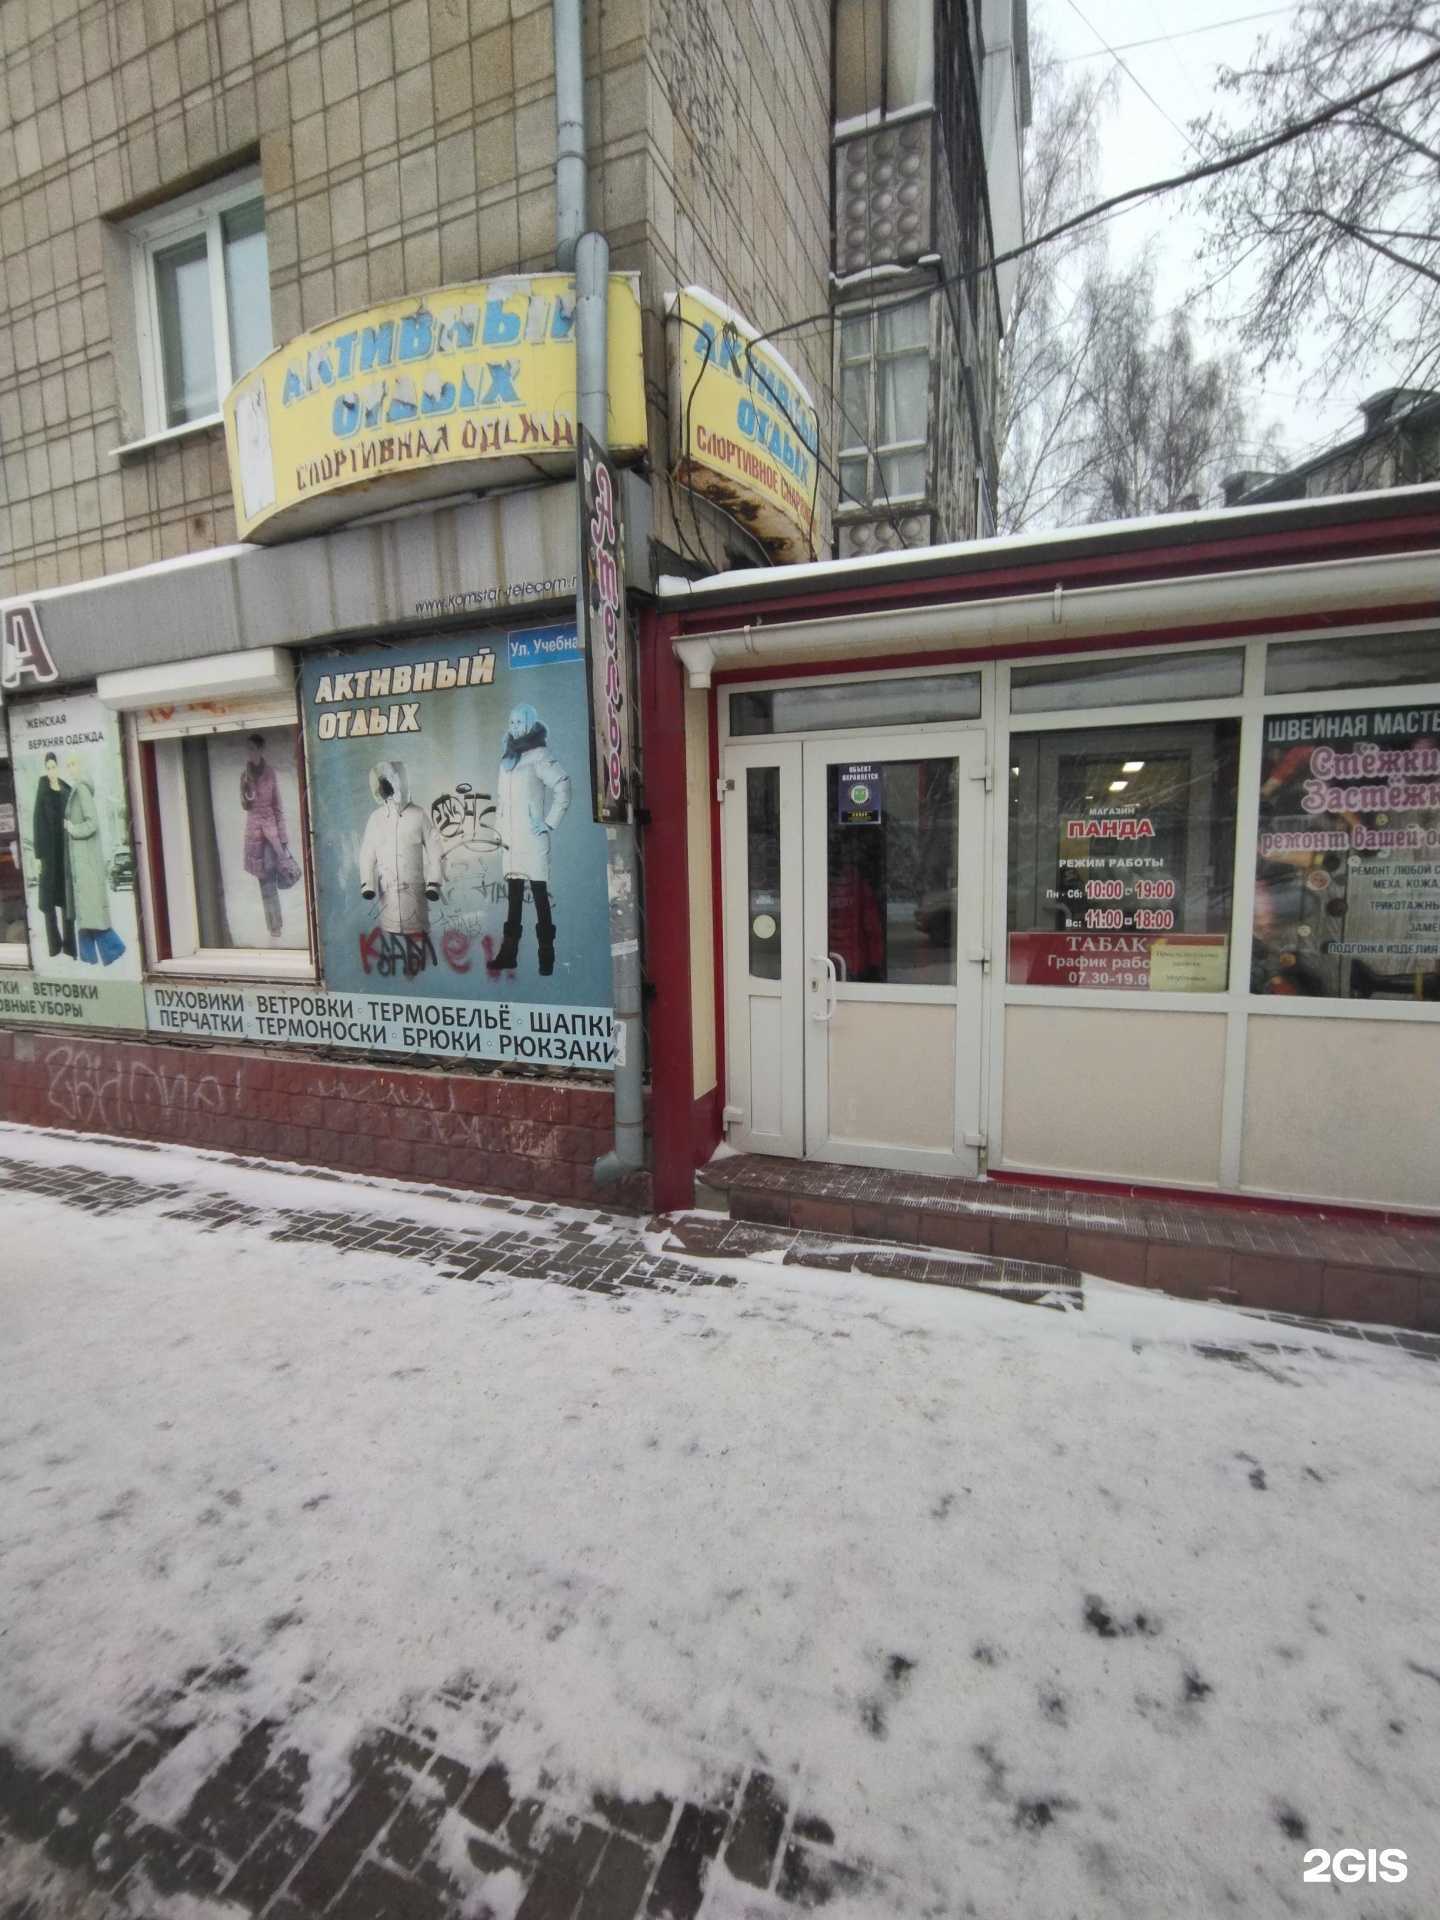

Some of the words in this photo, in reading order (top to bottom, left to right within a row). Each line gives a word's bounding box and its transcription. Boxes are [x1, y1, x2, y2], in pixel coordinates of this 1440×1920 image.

[332, 358, 525, 438] ОТДЫХ
[295, 423, 449, 491] СПОРТИВНАЯ
[462, 412, 576, 452] ОДЕЖД
[736, 397, 810, 486] ОТДЫХ
[697, 424, 778, 492] СПОРТИВНОЕ
[415, 575, 577, 613] www.komstar-telecom.r
[510, 641, 529, 658] Ул.
[533, 635, 577, 655] Учебна
[314, 648, 496, 704] АКТИВНЫЙ
[26, 714, 67, 728] ЖЕНСКАЯ
[317, 702, 421, 740] ОТДЫХ
[1268, 715, 1367, 741] ШВЕЙНАЯ
[28, 736, 64, 750] ВЕРХНЯЯ
[65, 731, 104, 746] ОДЕЖДА
[1310, 744, 1440, 779] Стёжки
[1089, 807, 1136, 816] МАГАЗИН
[1067, 818, 1155, 840] ПАНДА
[1261, 830, 1348, 856] ремонт
[1352, 825, 1419, 850] вашей
[1059, 858, 1106, 868] РЕЖИМ
[1108, 858, 1164, 868] РАБОТЫ
[1351, 865, 1390, 875] РЕМОНТ
[1394, 864, 1431, 874] ЛЮБОЙ
[1046, 889, 1059, 899] Пн
[1085, 880, 1123, 900] 10:00
[1135, 879, 1175, 900] 19:00
[1065, 919, 1082, 928] Вс:
[1085, 909, 1123, 929] 11:00
[1134, 909, 1174, 929] 18:00
[1066, 936, 1148, 953] ТАБАК
[1329, 943, 1384, 954] ПОДГОНКА
[1048, 954, 1107, 970] График
[1112, 956, 1150, 971] рабо
[1068, 972, 1150, 986] 07.30-19.0
[33, 982, 98, 999] ВЕТРОВКИ
[38, 1000, 83, 1017] УБОРЫ
[155, 989, 244, 1011] ПУХОВИКИ
[257, 995, 353, 1019] ВЕТРОВКИ
[368, 1001, 512, 1031] ТЕРМОБЕЛЬЁ
[160, 1010, 243, 1032] ПЕРЧАТКИ
[256, 1016, 386, 1044] ТЕРМОНОСКИ
[402, 1026, 481, 1053] БРЮКИ
